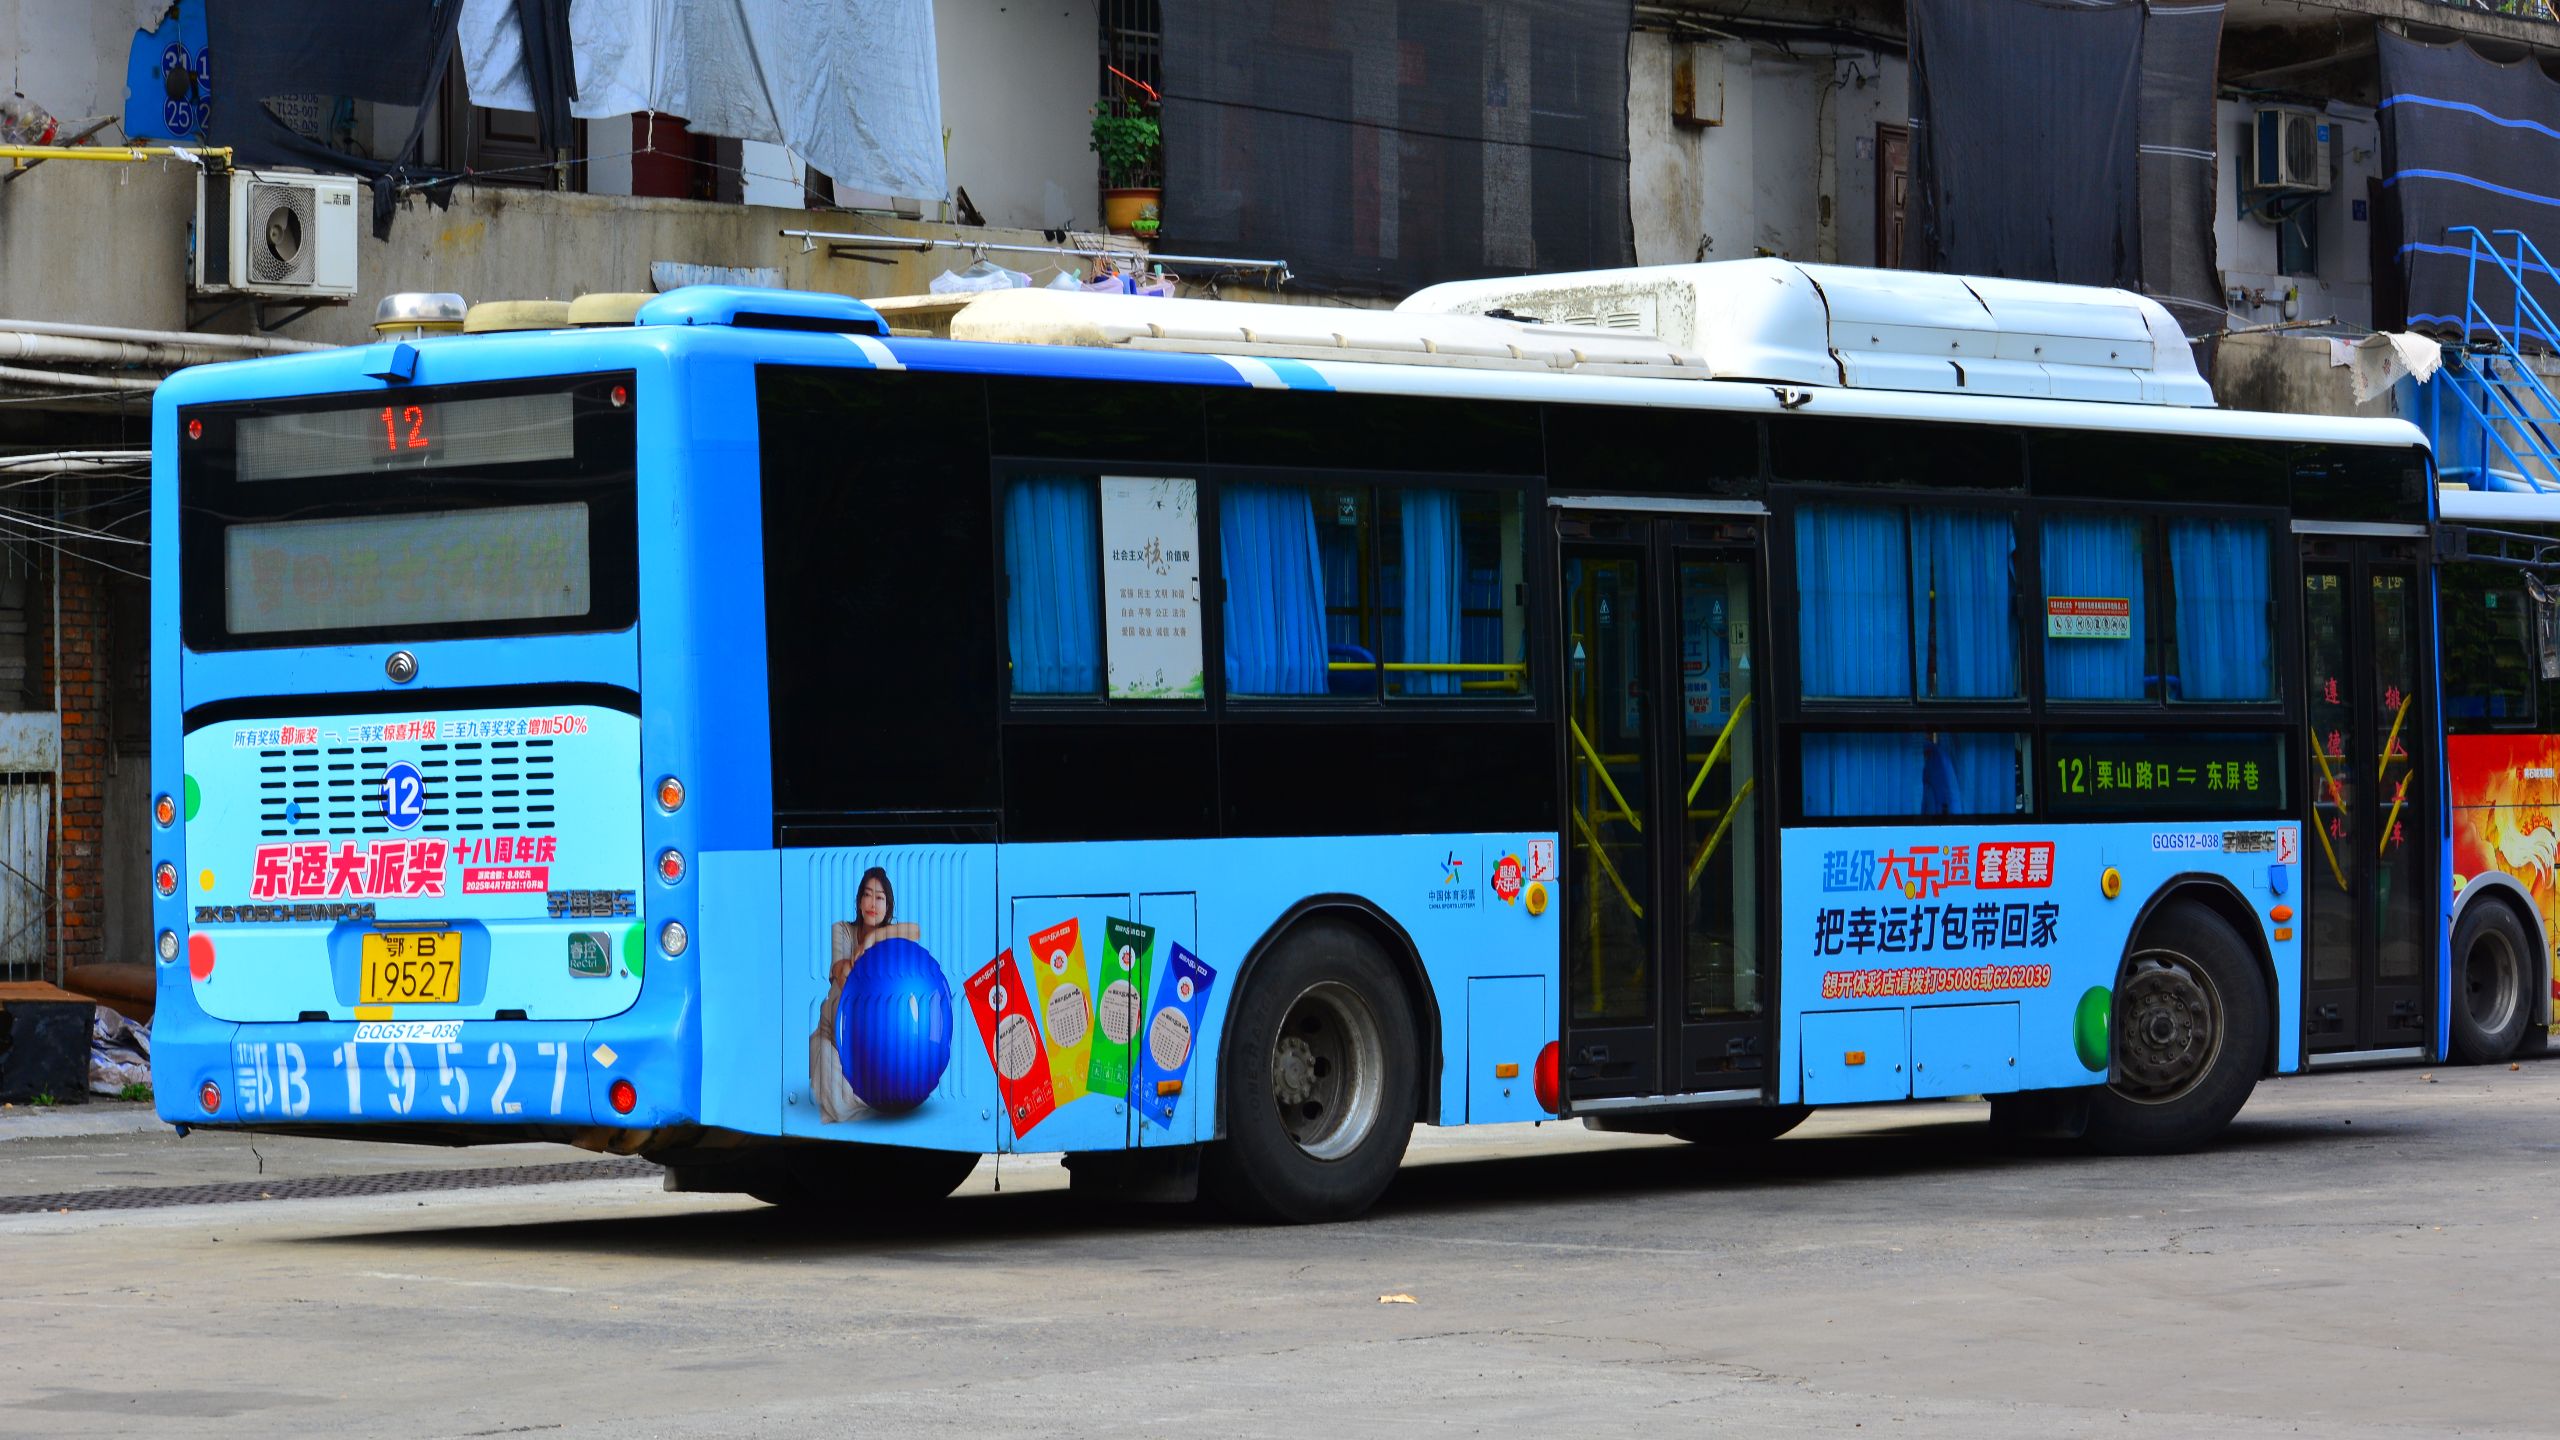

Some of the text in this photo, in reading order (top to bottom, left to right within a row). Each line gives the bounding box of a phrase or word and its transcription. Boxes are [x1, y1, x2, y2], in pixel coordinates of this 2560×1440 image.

[167, 100, 190, 128] 25
[277, 102, 319, 119] TL25-007
[381, 405, 428, 451] 12
[234, 725, 318, 747] 所有奖级都派奖
[442, 714, 588, 739] 三至九等奖奖金增加50%
[2323, 676, 2348, 840] 遵德守礼
[2384, 685, 2409, 850] 排队上车
[2057, 758, 2260, 794] 12 栗山路口 东屏巷
[383, 776, 420, 815] 12
[2152, 833, 2219, 849] GQGS12-038
[251, 835, 558, 899] 乐透大派奖 十八周年庆
[1822, 845, 2051, 900] 超级大乐透 套餐票
[466, 880, 545, 892] 2025年4月7日21:10开始
[1428, 889, 1476, 902] 中国体育彩票
[1814, 900, 2060, 957] 把幸运打包带回家
[570, 941, 597, 960] 睿控
[370, 961, 455, 998] 19527
[1822, 964, 2052, 999] 想开体彩店请拨打95086或6262039
[356, 1023, 460, 1041] GQGS12-038
